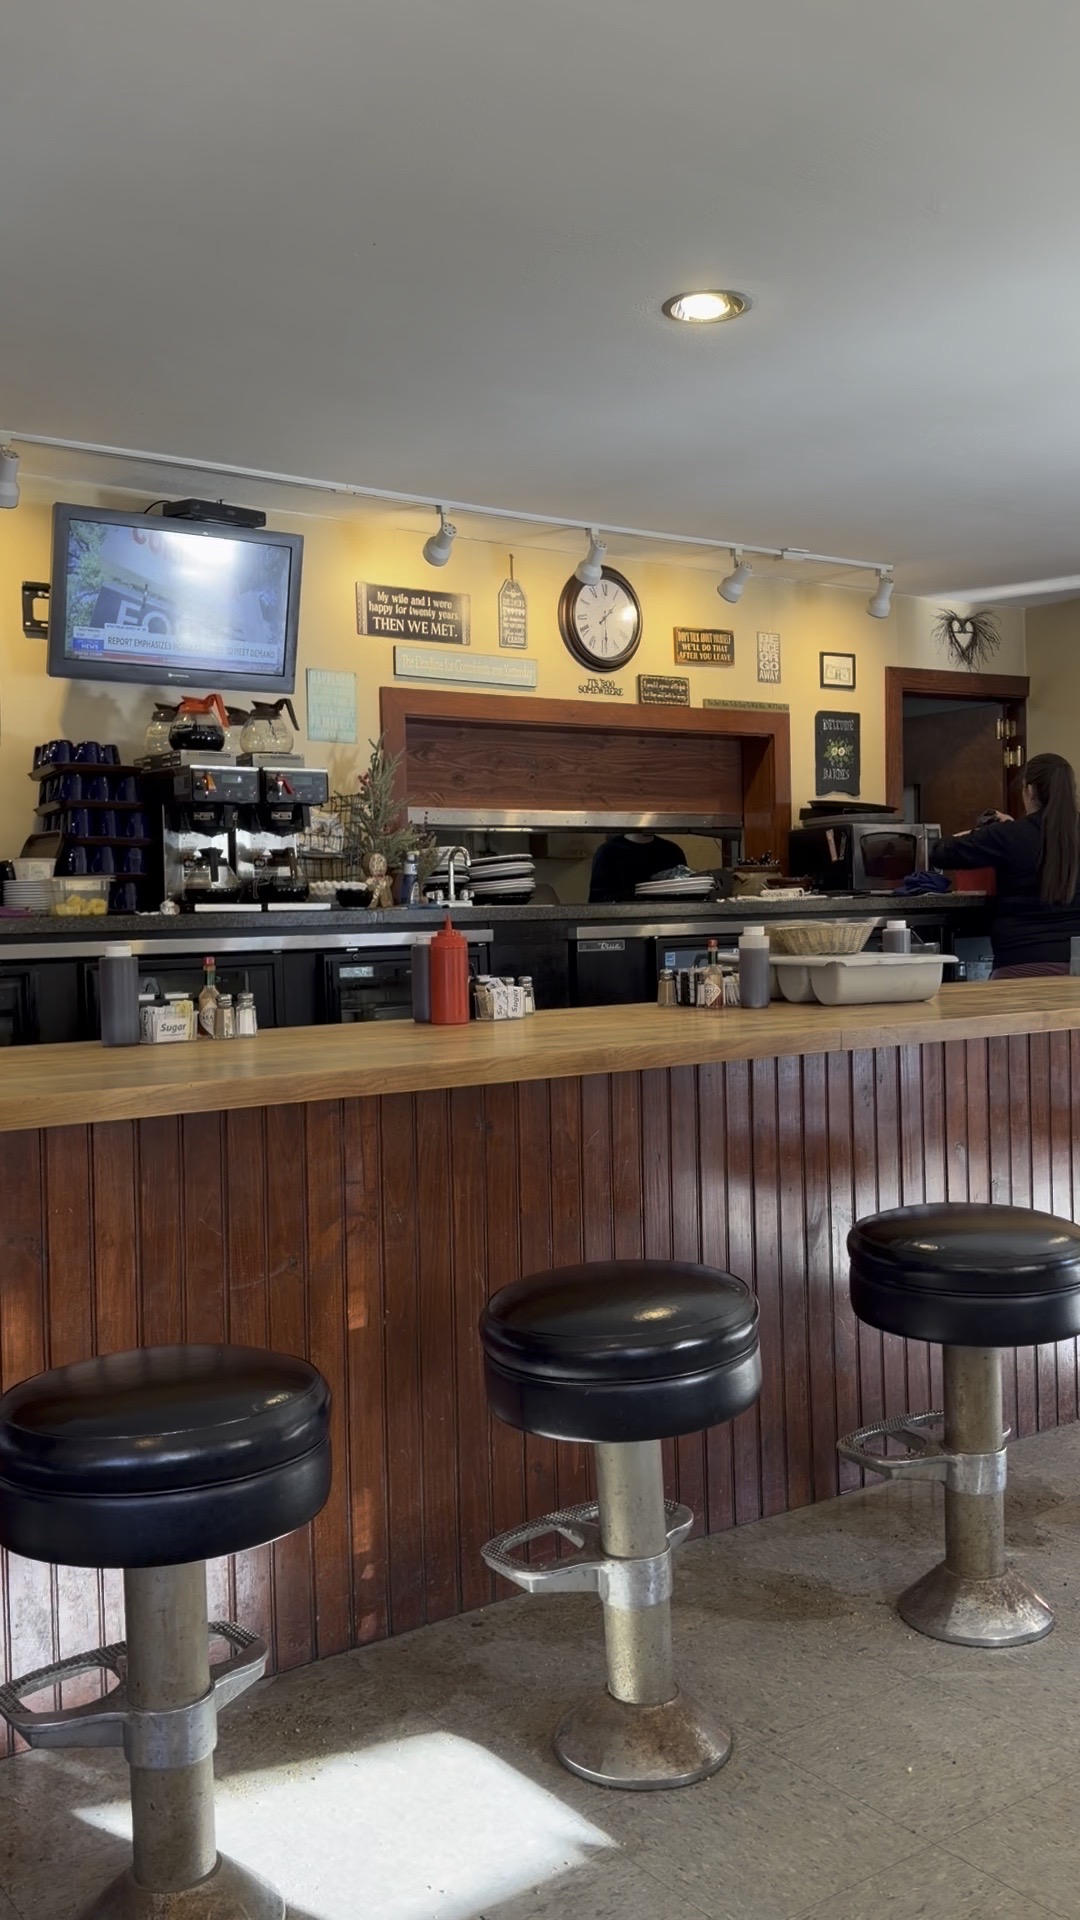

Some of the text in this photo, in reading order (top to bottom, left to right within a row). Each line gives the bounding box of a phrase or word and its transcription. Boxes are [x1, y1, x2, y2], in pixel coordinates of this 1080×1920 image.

[377, 590, 452, 609] My wife and I were
[369, 601, 460, 621] happy for twenty years.
[372, 617, 458, 637] THEN WE MET.
[108, 636, 133, 647] REPORT
[134, 639, 172, 650] EMPHASIZES
[759, 633, 779, 643] BE
[682, 643, 700, 651] WE'LL
[713, 645, 728, 653] THAT
[759, 642, 779, 653] NICE
[678, 651, 731, 661] AFTER YOU LEAVE
[759, 652, 779, 662] OR
[759, 661, 780, 671] GO
[759, 670, 779, 680] AWAY
[578, 685, 624, 696] SOMEWHERE
[160, 1022, 187, 1034] Sugar
